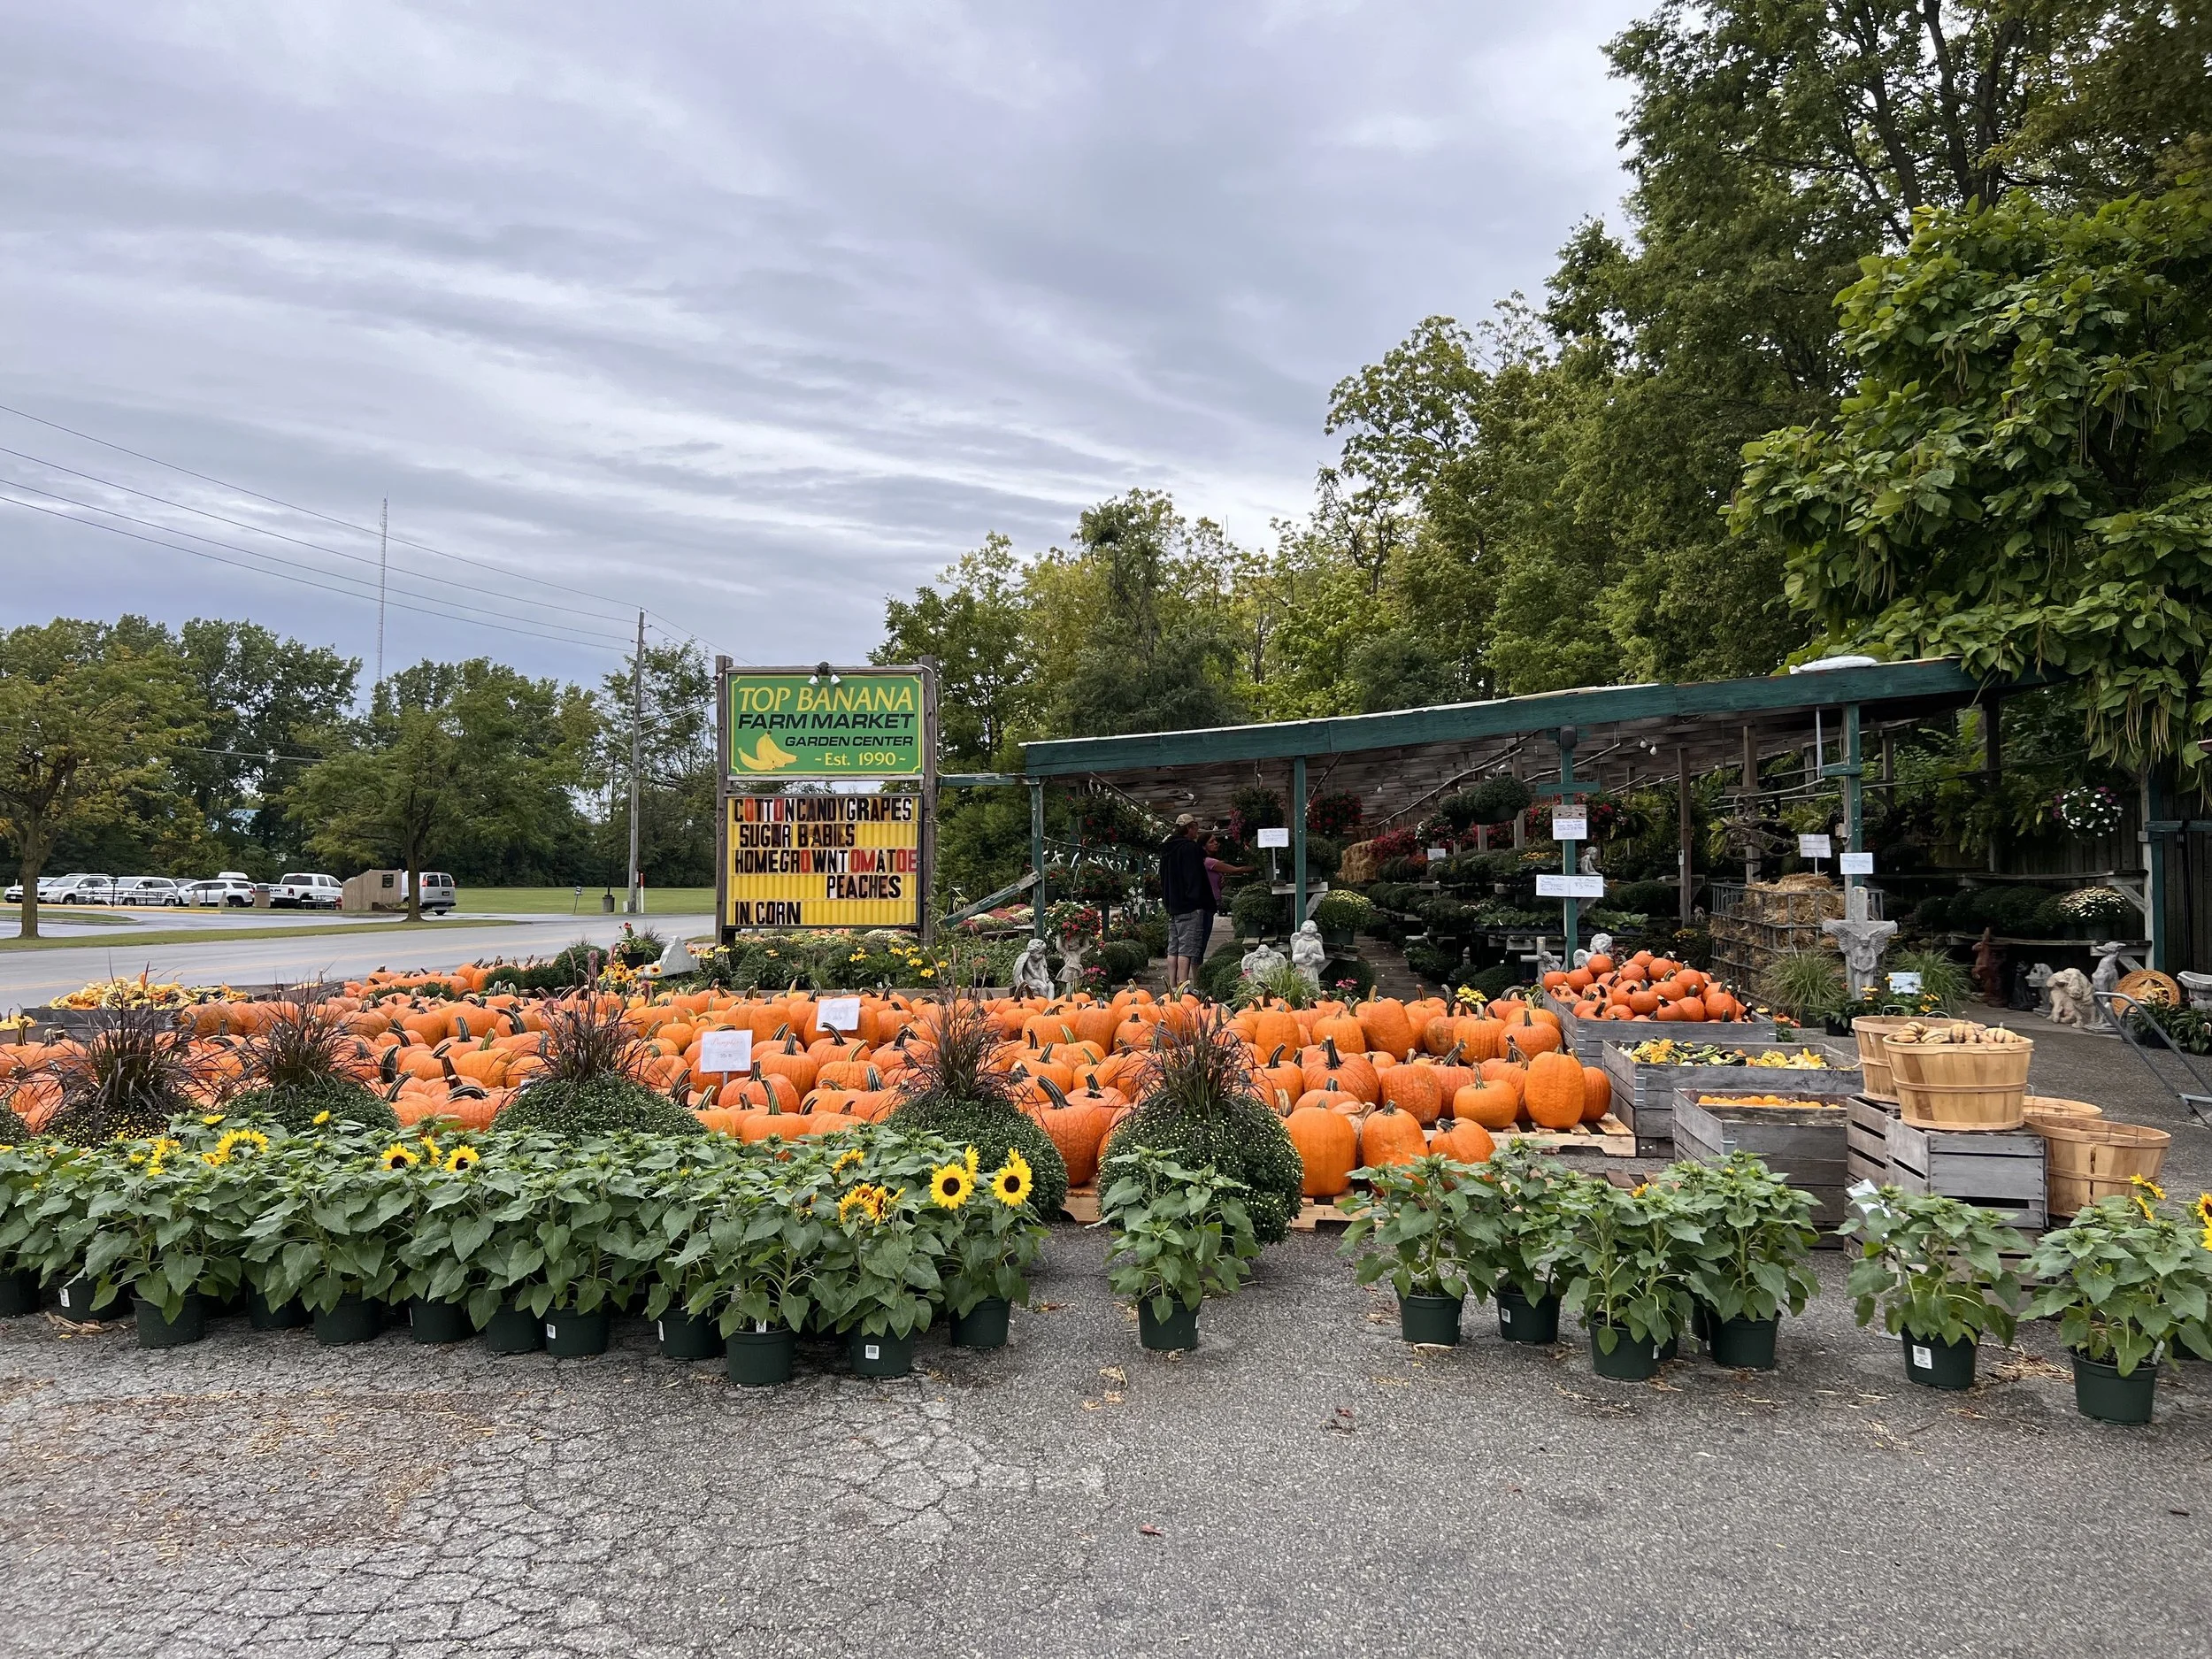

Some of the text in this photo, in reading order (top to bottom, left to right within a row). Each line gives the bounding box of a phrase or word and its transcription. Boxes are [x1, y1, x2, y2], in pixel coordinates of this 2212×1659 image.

[738, 687, 914, 712] TOP BANANA
[738, 713, 915, 730] FARM MARKET
[785, 736, 913, 747] GARDEN CENTER
[734, 798, 912, 822] COTTON CANDY GRAPES
[739, 824, 792, 848] SUGAR
[826, 875, 902, 899] PEACHES
[756, 901, 802, 925] CORN
